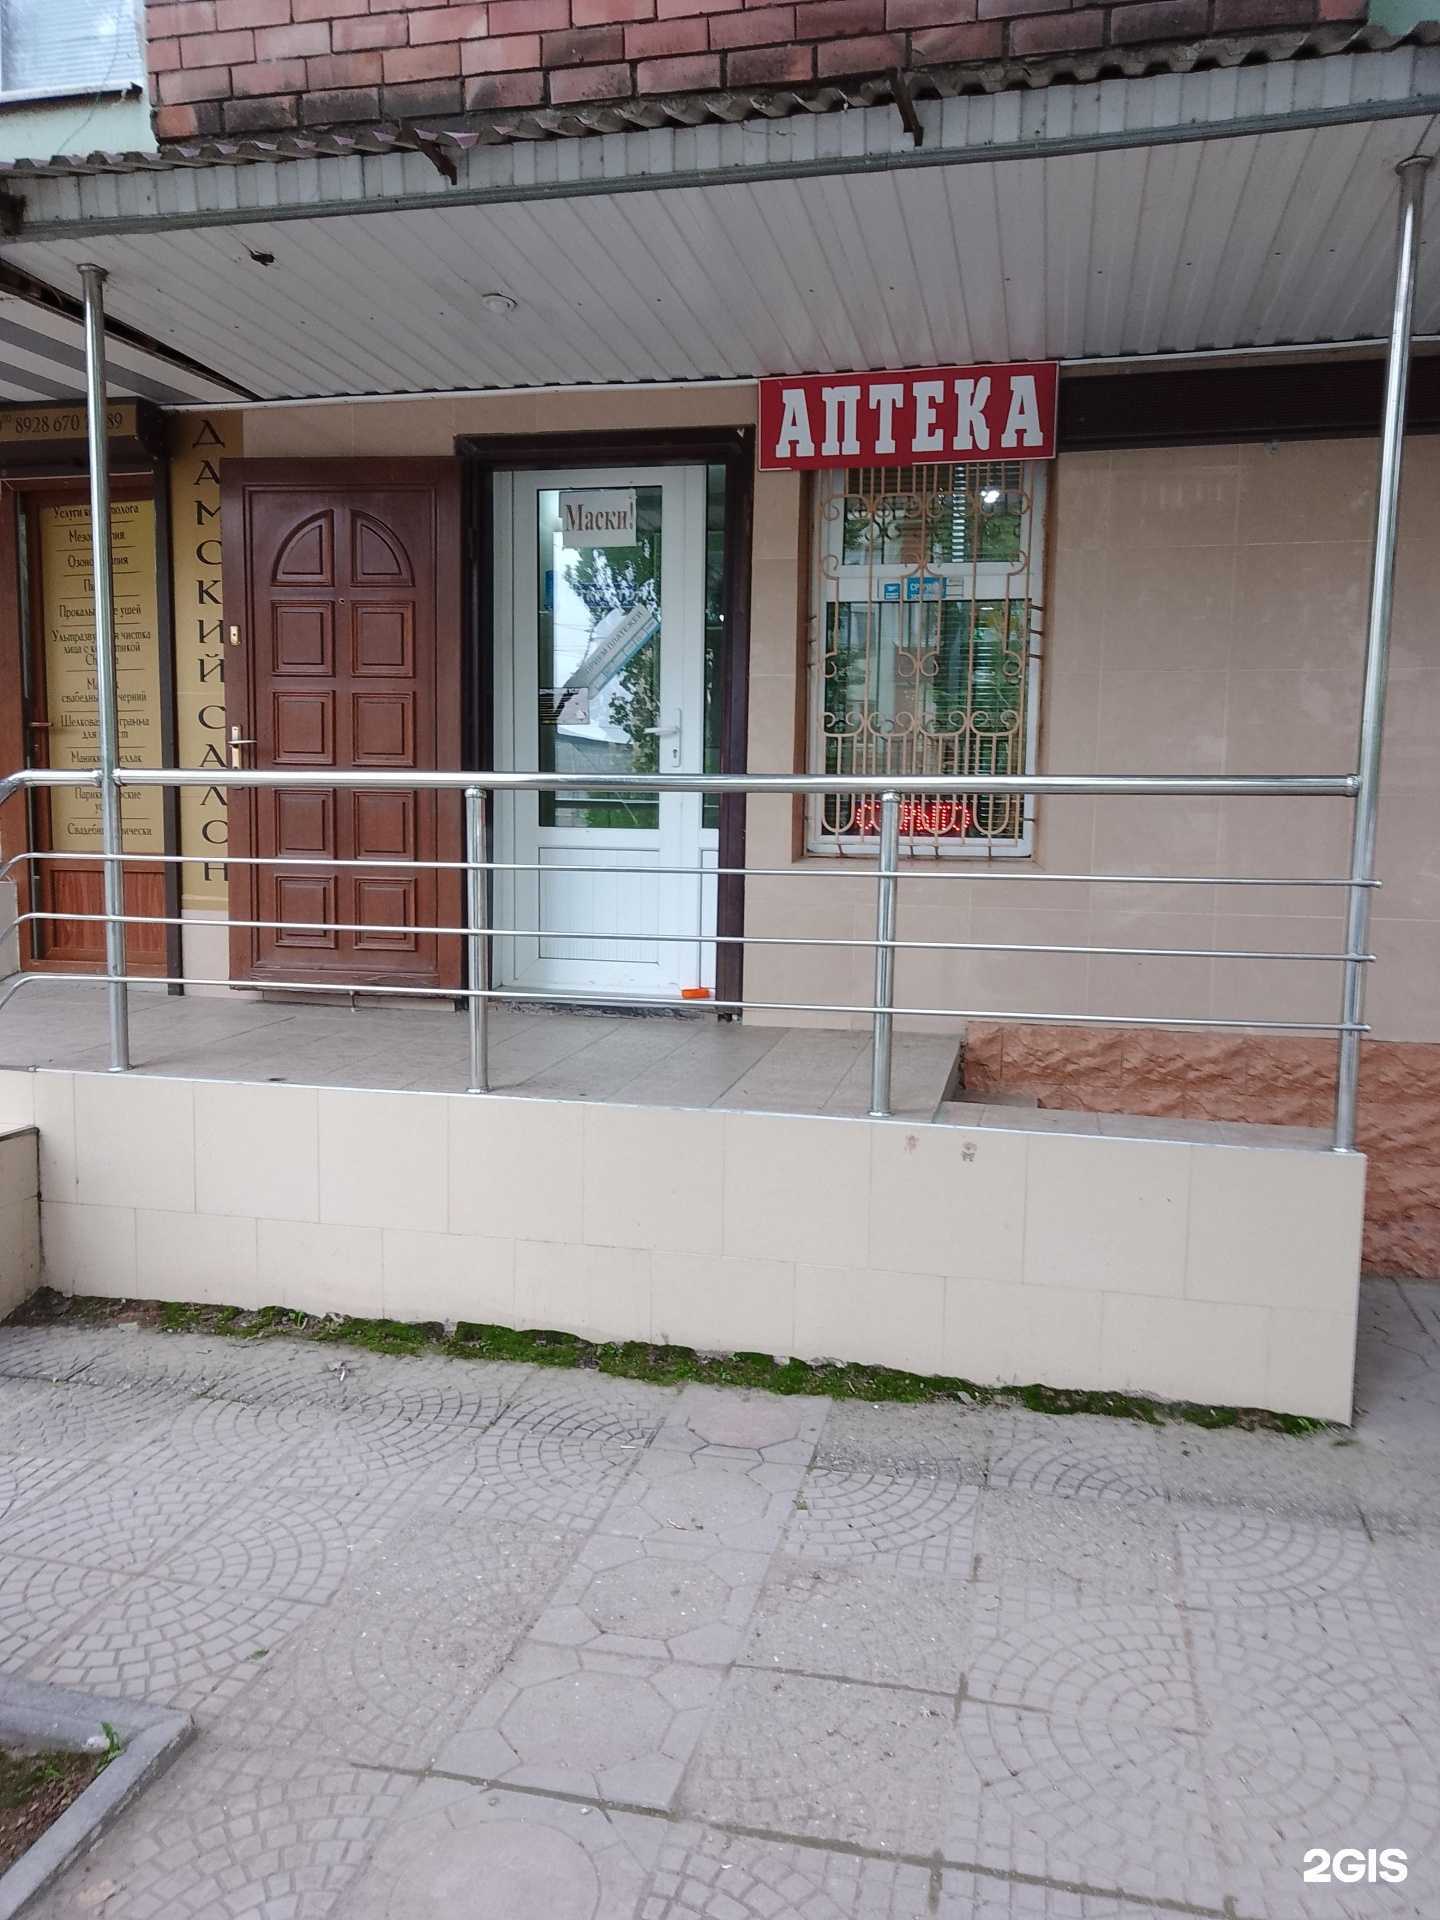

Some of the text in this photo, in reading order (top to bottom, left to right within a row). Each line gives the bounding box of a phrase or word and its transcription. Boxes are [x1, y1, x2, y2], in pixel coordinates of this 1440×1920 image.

[16, 416, 50, 434] 8928
[53, 414, 80, 432] 670
[776, 375, 1043, 458] АПТЕКА
[565, 502, 633, 532] Маски!
